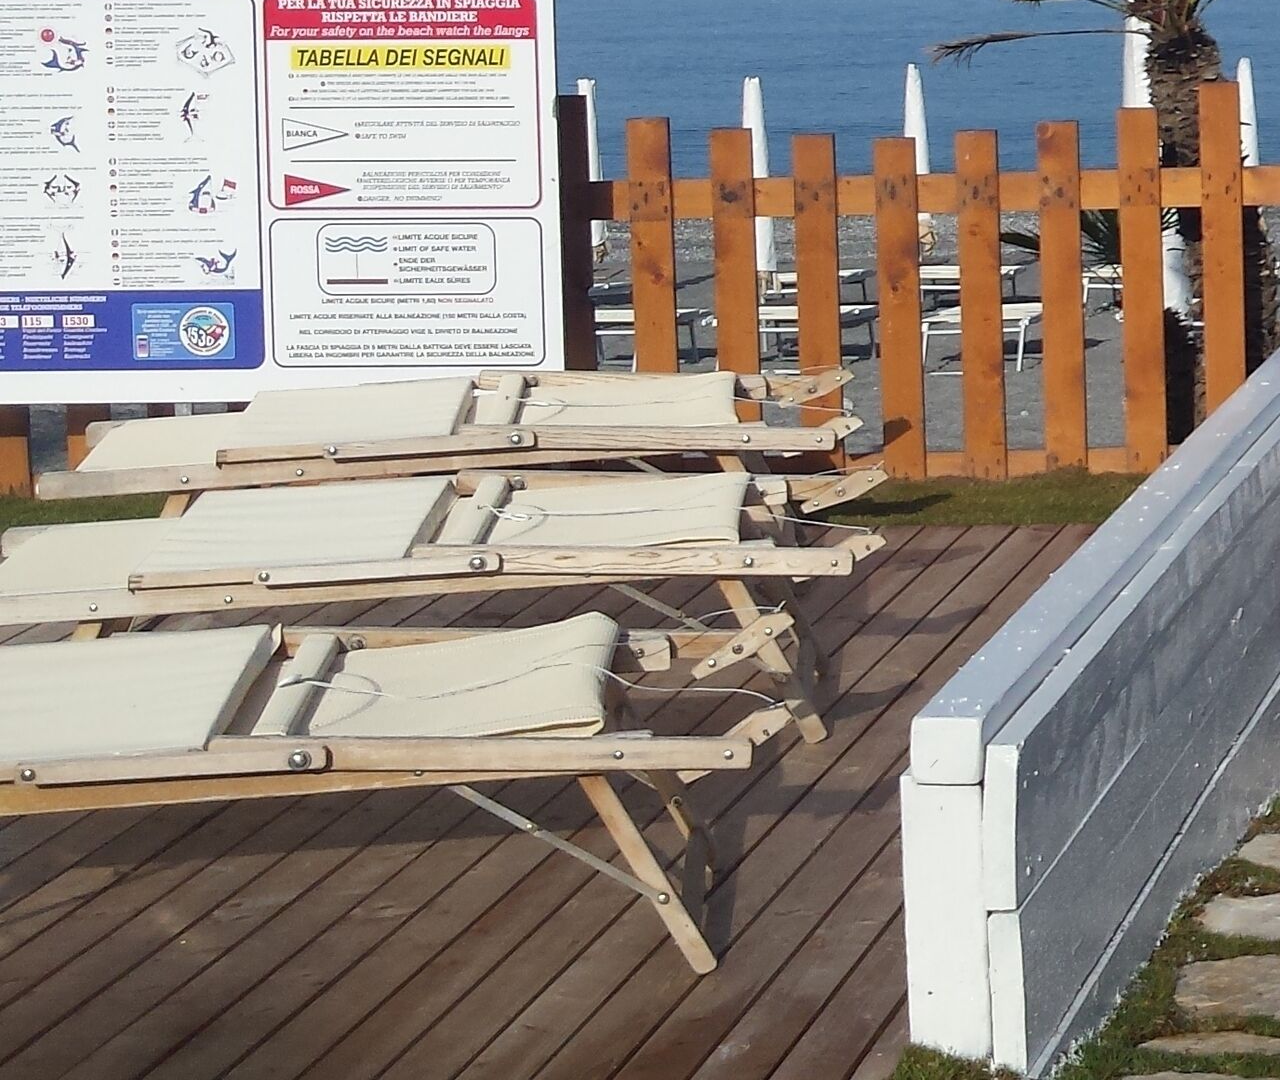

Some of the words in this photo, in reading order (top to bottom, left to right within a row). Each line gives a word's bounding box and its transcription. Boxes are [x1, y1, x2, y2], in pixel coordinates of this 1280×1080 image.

[321, 11, 387, 23] RISPETTA
[389, 11, 407, 22] LE
[409, 11, 478, 22] BANDIERE
[270, 26, 290, 37] For
[292, 28, 319, 38] your
[321, 26, 357, 38] safety
[359, 28, 374, 36] on
[376, 26, 394, 36] the
[396, 26, 434, 36] beach
[436, 26, 471, 36] watch
[473, 26, 492, 36] the
[296, 49, 380, 66] TABELLA
[385, 48, 417, 66] DEI
[422, 48, 505, 65] SEGNALI
[286, 130, 318, 138] BIANCA
[290, 185, 320, 195] ROSSA
[23, 317, 42, 326] 115
[63, 317, 90, 326] 1530
